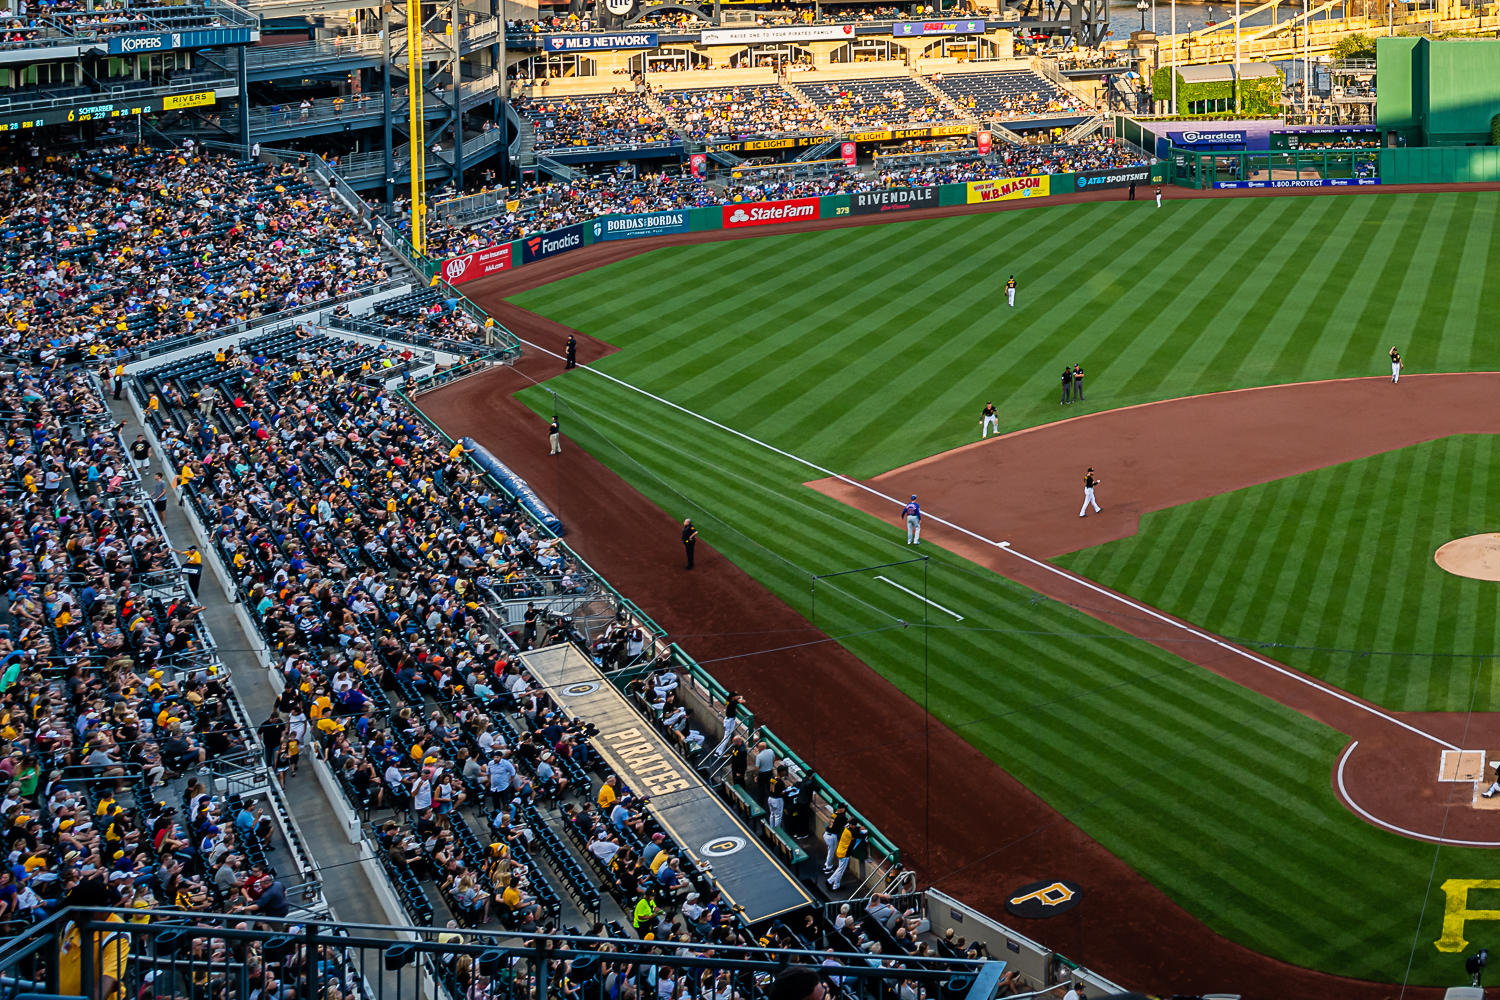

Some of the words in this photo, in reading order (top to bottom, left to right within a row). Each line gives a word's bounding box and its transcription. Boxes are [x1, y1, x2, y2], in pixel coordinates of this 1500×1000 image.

[121, 36, 162, 52] KOPPERS
[566, 37, 591, 49] MLB
[593, 35, 649, 47] NETWORK
[172, 93, 207, 103] RIVERS
[67, 110, 75, 121] 6
[78, 105, 114, 115] SCHWARBER
[895, 130, 902, 138] IC
[902, 128, 928, 137] LIGHT
[946, 126, 969, 134] LIGHT
[799, 138, 808, 146] IC
[809, 136, 833, 145] LIGHT
[863, 132, 885, 140] LIGHT
[1184, 131, 1241, 142] Guardian
[760, 140, 787, 148] LIGHT
[1087, 177, 1106, 185] AT&T
[1106, 173, 1148, 183] SPORTSNET
[1271, 180, 1323, 188] 1.800.PROTECT
[981, 178, 1040, 201] W.B.MASON
[858, 188, 932, 206] RIVENDALE
[607, 217, 643, 231] BORDAS
[647, 214, 683, 227] BORDAS
[543, 233, 580, 254] Fanatics
[479, 253, 489, 261] Auto
[490, 248, 508, 258] Insurance
[447, 261, 465, 276] AAA
[484, 262, 504, 273] AAA.com
[603, 727, 691, 797] PIRATES
[1011, 881, 1076, 907] P
